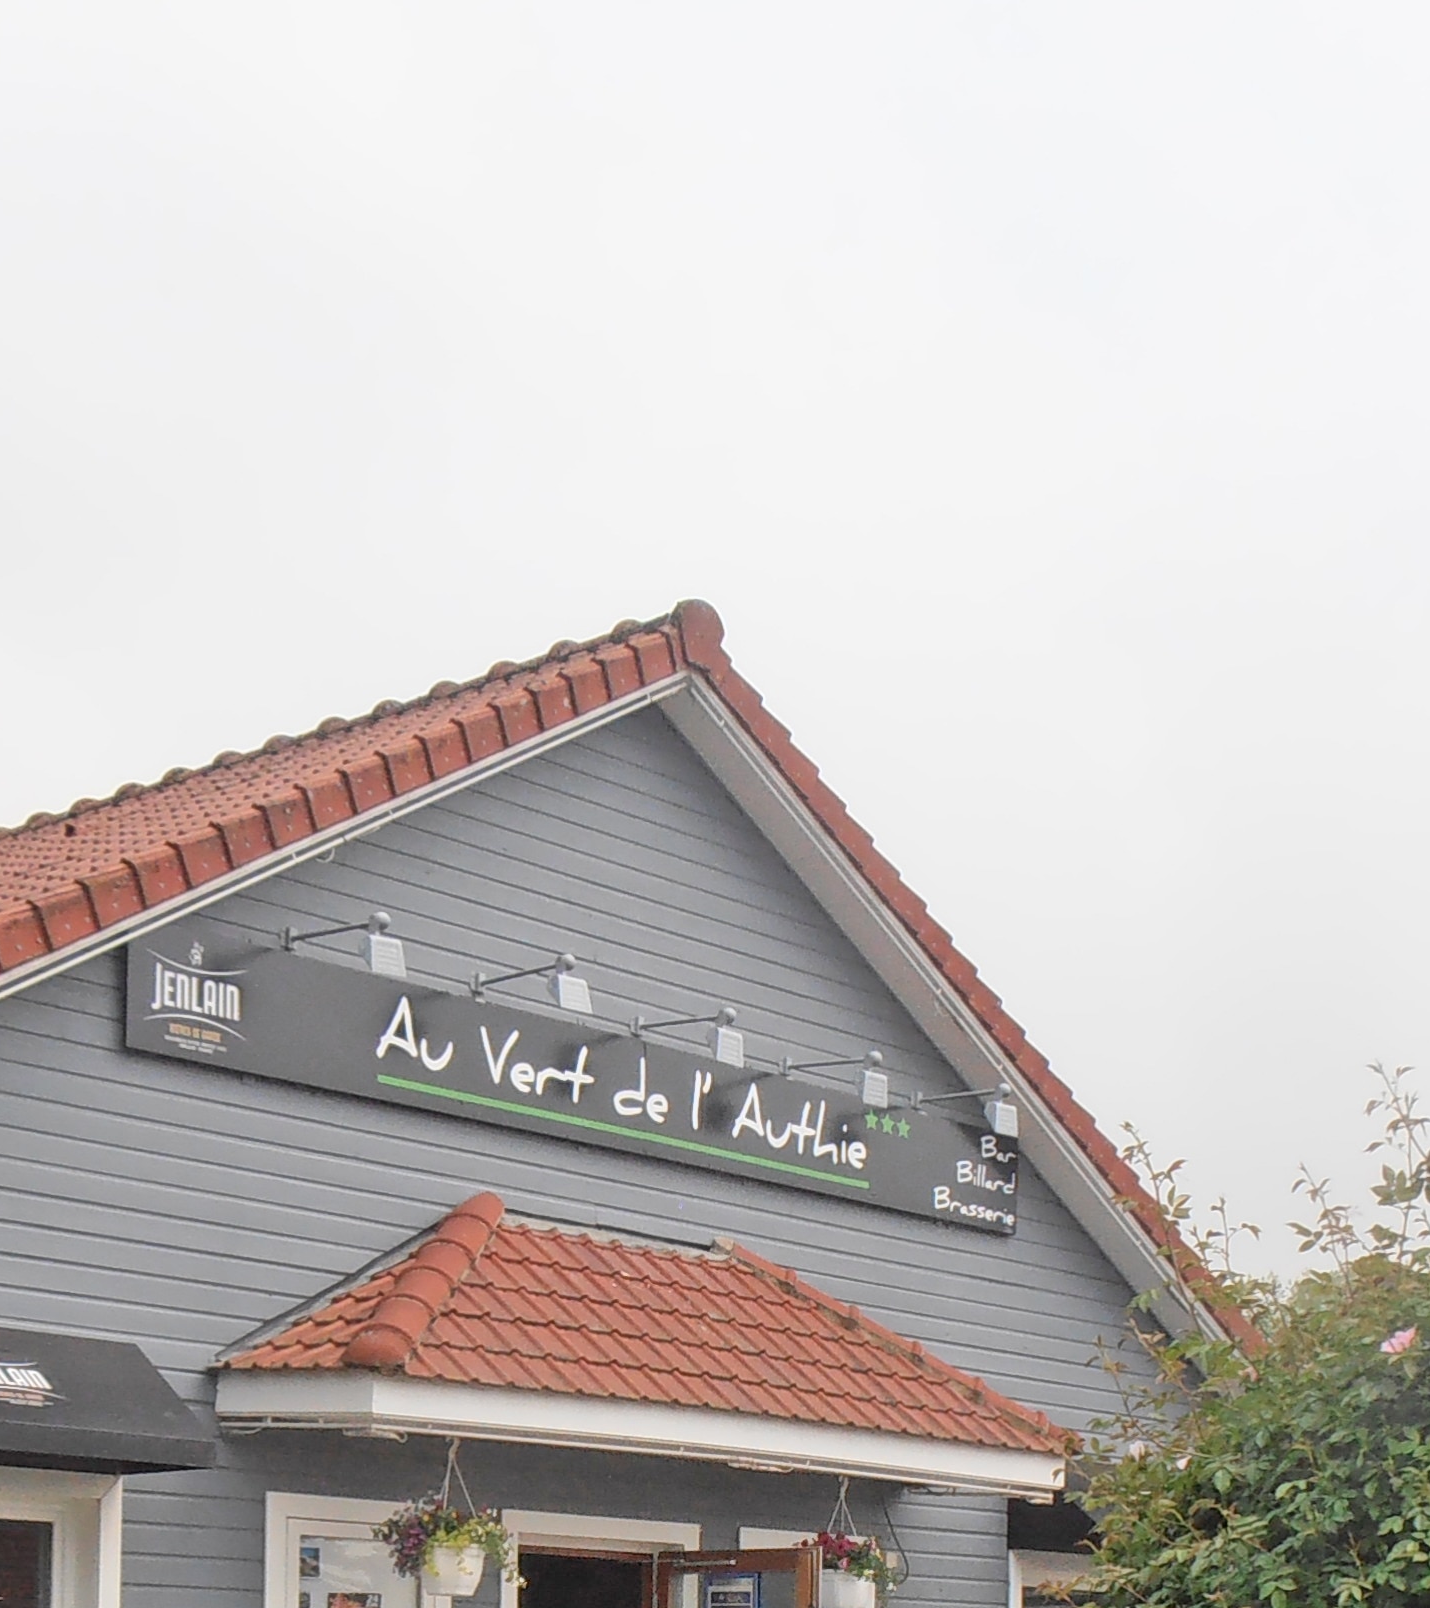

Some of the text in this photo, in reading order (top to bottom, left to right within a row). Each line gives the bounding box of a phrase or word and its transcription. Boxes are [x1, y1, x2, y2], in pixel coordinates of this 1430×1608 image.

[151, 962, 241, 1021] JENLAIN
[375, 996, 867, 1170] Au Vert de l' Authie
[980, 1135, 1016, 1163] Bar
[956, 1160, 1015, 1194] Billard
[933, 1186, 1015, 1226] Brasserie
